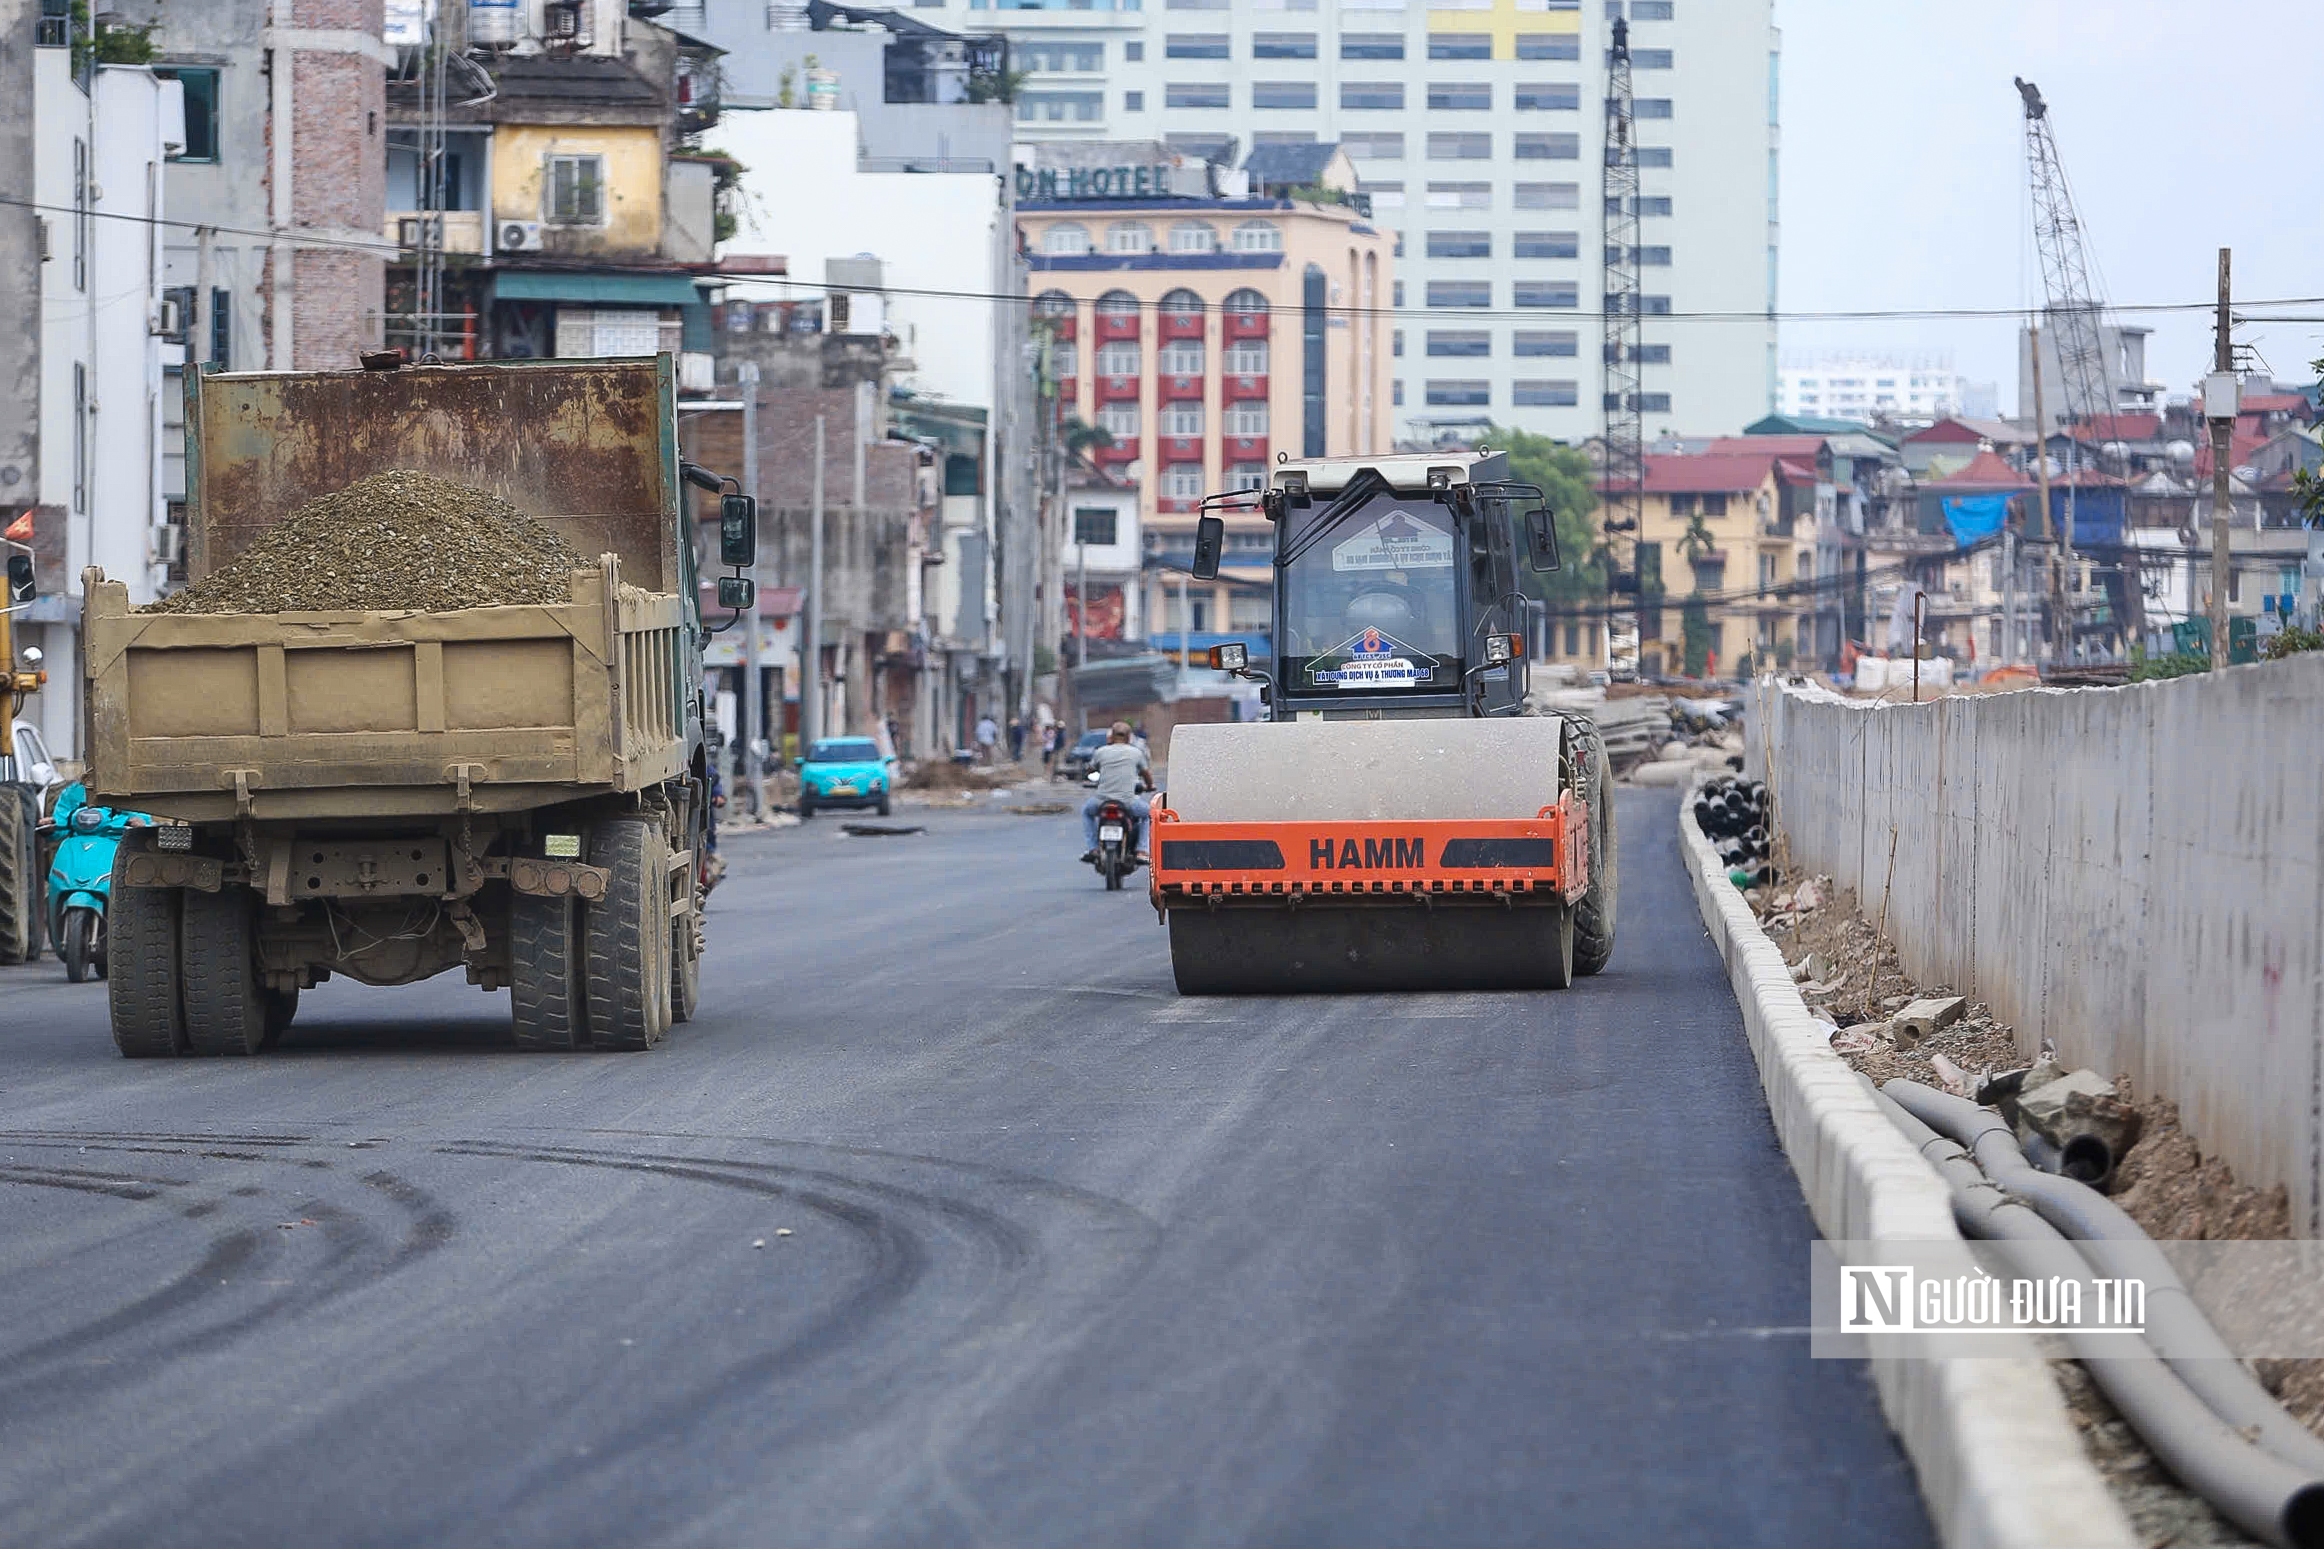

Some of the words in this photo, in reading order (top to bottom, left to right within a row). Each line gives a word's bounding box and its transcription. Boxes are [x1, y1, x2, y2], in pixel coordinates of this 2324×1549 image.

[1070, 165, 1168, 198] HOTEL
[1349, 670, 1364, 681] DỊCH
[1364, 670, 1374, 681] VỤ
[1374, 670, 1380, 679] &
[1310, 838, 1424, 869] HAMM
